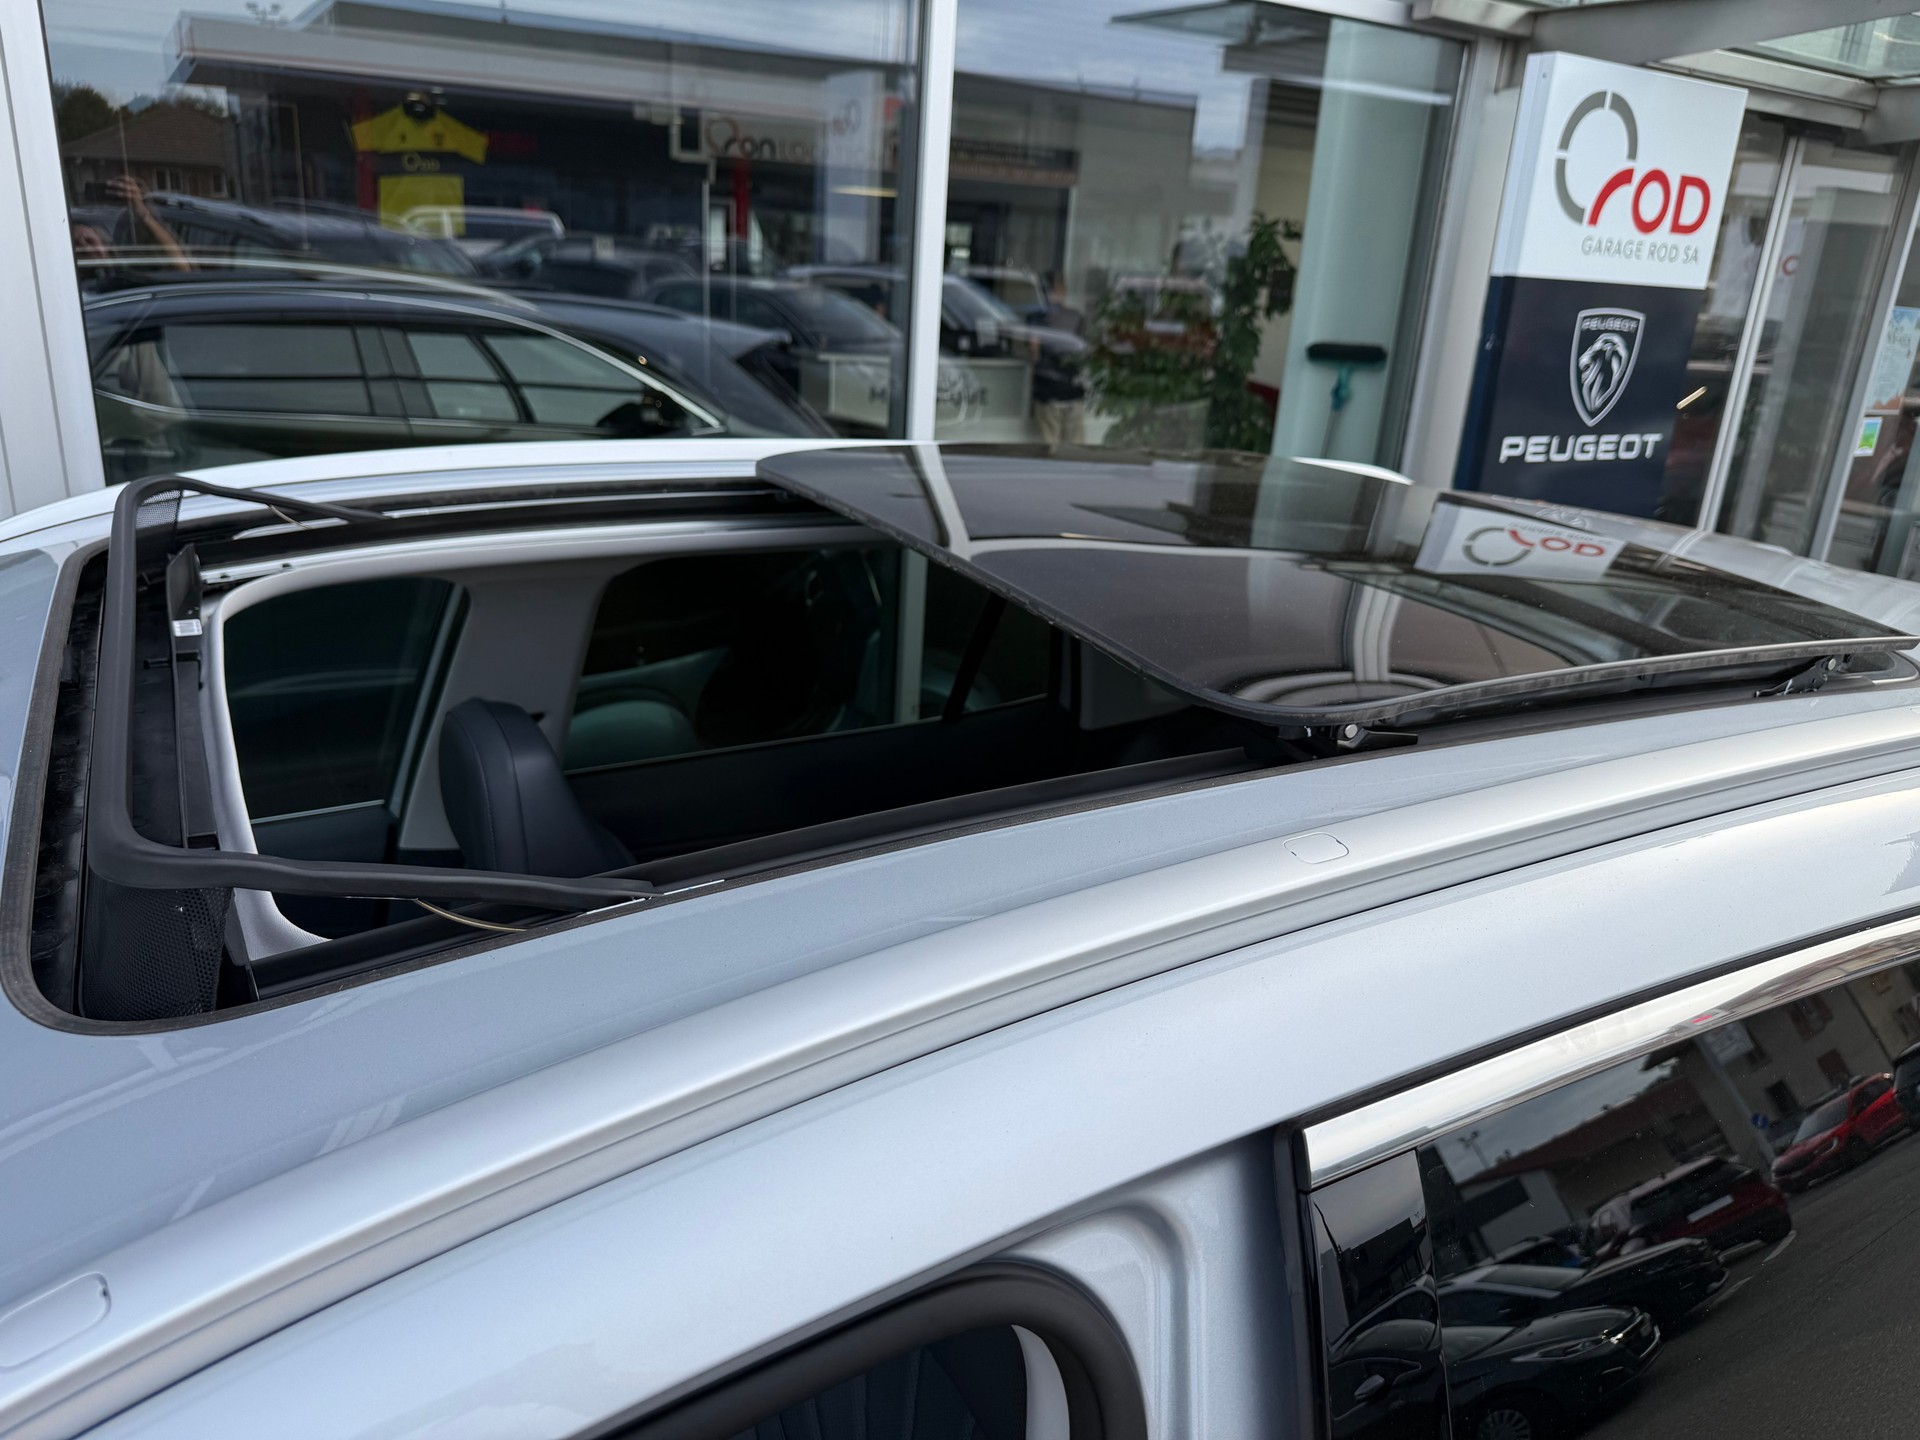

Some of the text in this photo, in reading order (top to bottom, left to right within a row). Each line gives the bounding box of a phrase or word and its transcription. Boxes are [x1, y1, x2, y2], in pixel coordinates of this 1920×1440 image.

[1581, 235, 1699, 265] GARAGE ROD SA
[1581, 316, 1639, 333] PEUGEOT
[1499, 433, 1663, 464] PEUGEOT
